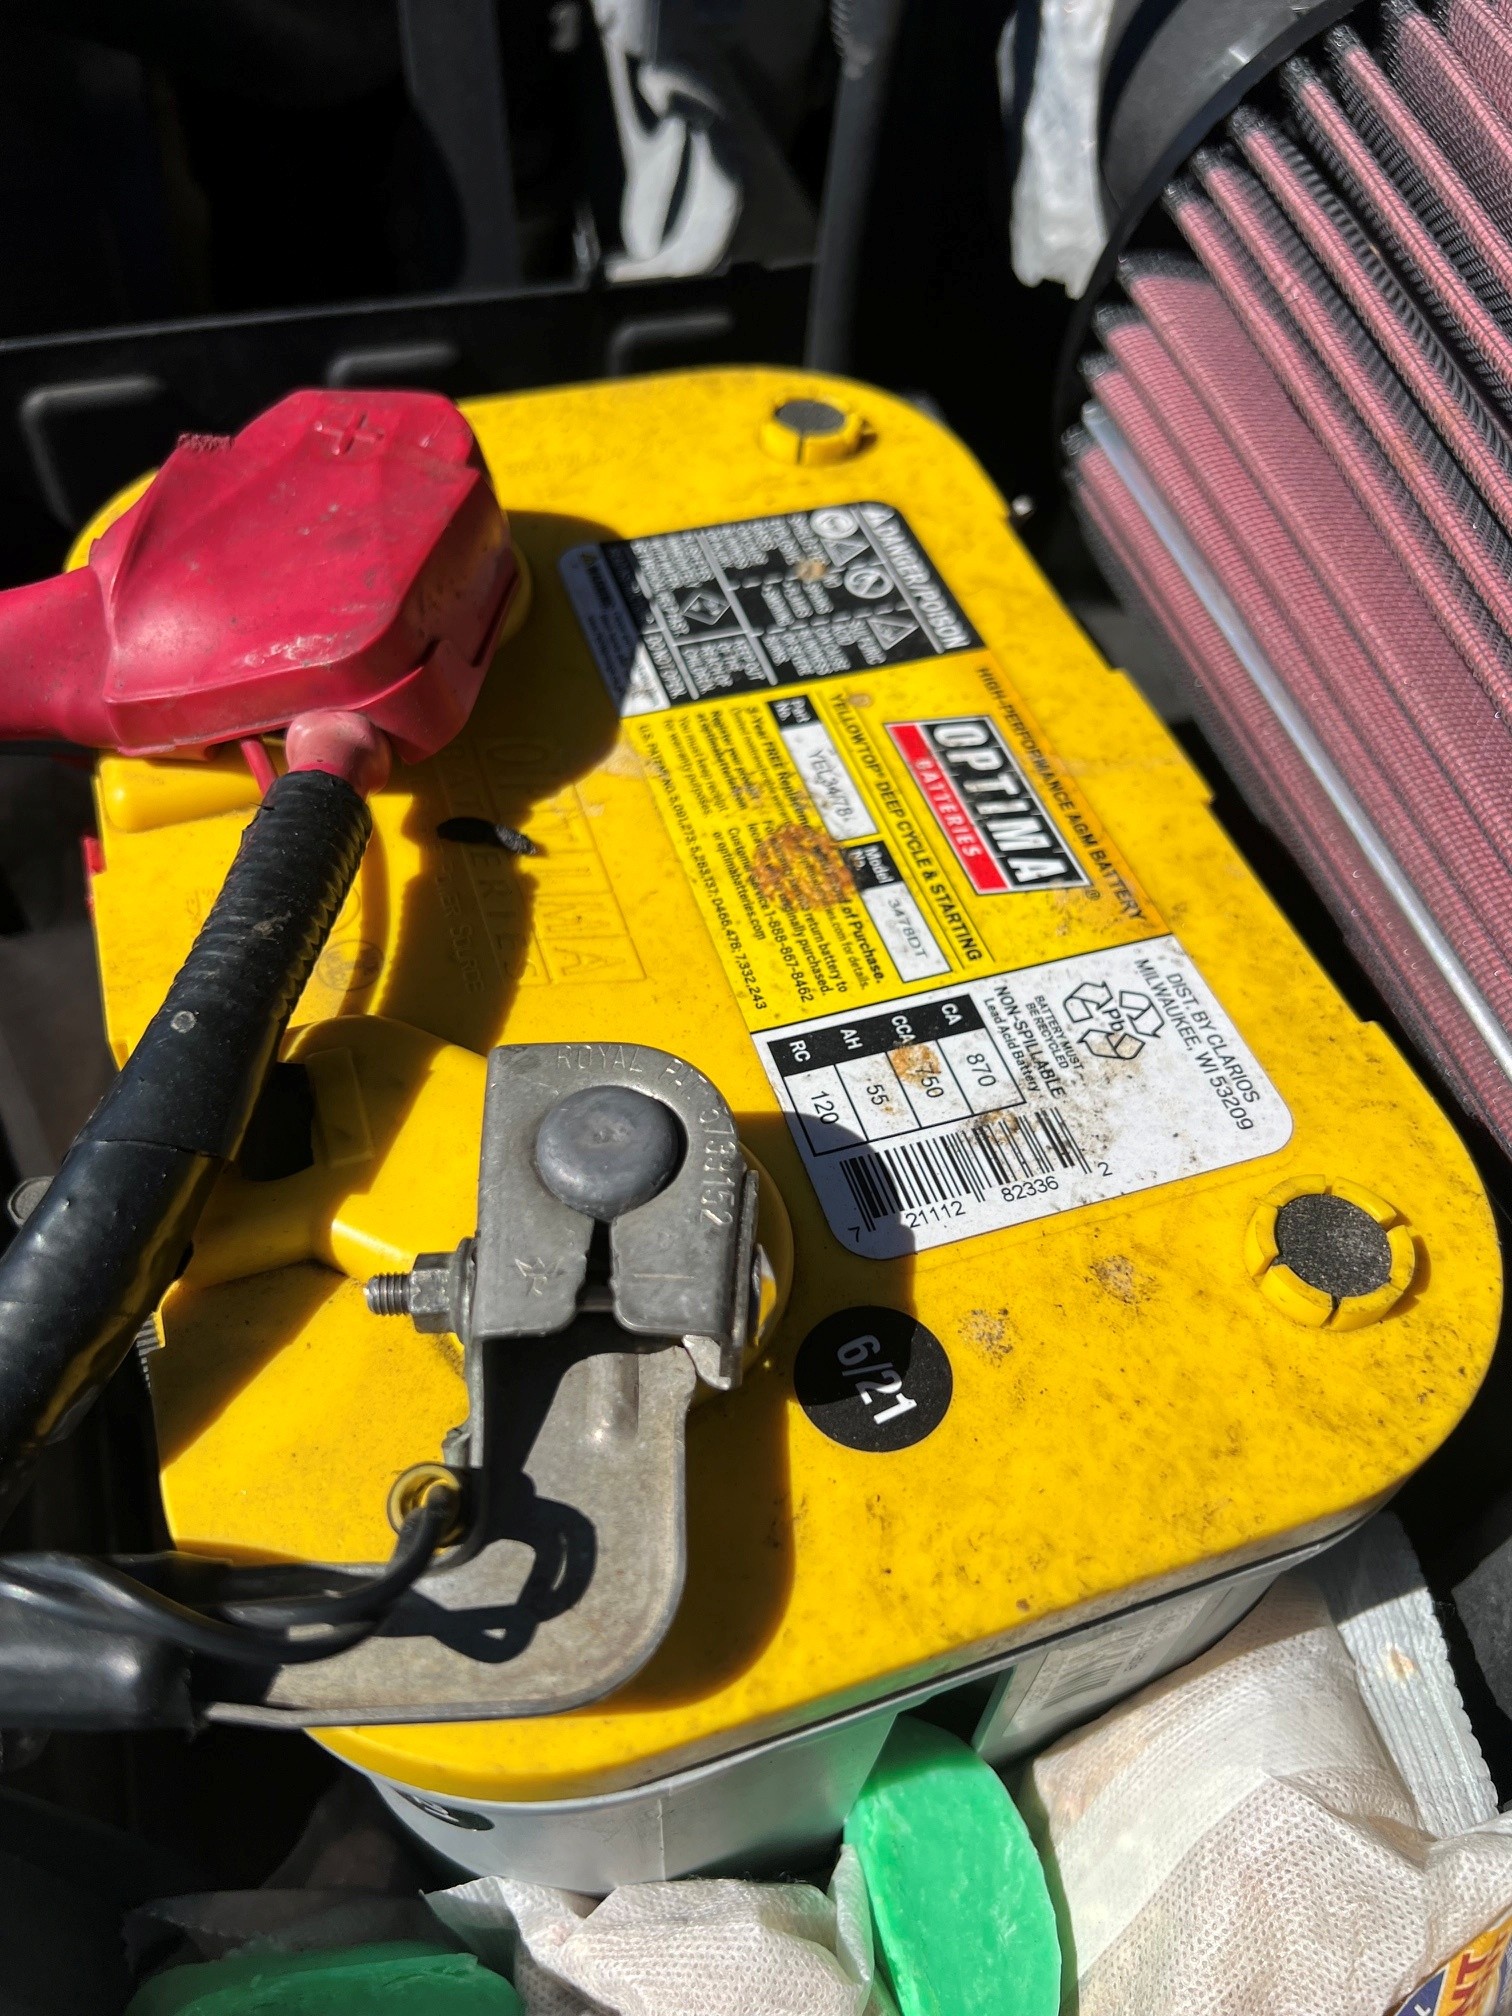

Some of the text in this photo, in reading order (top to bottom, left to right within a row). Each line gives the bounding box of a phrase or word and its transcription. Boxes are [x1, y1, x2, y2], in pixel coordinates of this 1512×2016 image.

[871, 524, 973, 649] DANGER/POISON
[772, 702, 794, 720] No.
[787, 699, 813, 722] Part
[873, 781, 907, 819] DEEP
[912, 758, 983, 858] BATTERIES
[932, 723, 1068, 882] OPTIMA
[974, 667, 1147, 922] HIGH-PERFORMANCE AGM BATTERY
[761, 740, 785, 768] FREE
[848, 920, 889, 983] Purchase.
[847, 850, 870, 871] No.
[862, 847, 894, 883] Model
[894, 819, 934, 870] CYCLE
[920, 869, 940, 881] &
[714, 842, 768, 941] optimabatteries.com
[886, 898, 928, 959] 3478DT
[928, 883, 983, 961] STARTING
[733, 953, 768, 1010] 7,332,243
[763, 911, 815, 1003] 1-888-867-8462
[796, 938, 835, 996] purchased.
[803, 913, 824, 942] return
[815, 943, 843, 980] battery
[846, 956, 871, 990] details.
[556, 1044, 643, 1073] ROYAL
[888, 1014, 947, 1099] CCA 750
[938, 1002, 998, 1088] CA 870
[982, 997, 1043, 1093] Lead Acid Battery
[992, 985, 1067, 1101] NON-SPILLABLE
[1024, 1002, 1070, 1069] BE RECYCLED
[1033, 995, 1084, 1070] BATTERY MUST
[1100, 1008, 1128, 1032] Pb
[1132, 958, 1255, 1131] MILWAUKEE, WI 53209
[1164, 972, 1262, 1104] DIST. BY CLARIOS
[788, 1039, 840, 1126] RC 120
[839, 1026, 890, 1106] AH 55
[848, 1161, 1114, 1243] 7 21112 82336 2
[837, 1334, 918, 1425] 6/21
